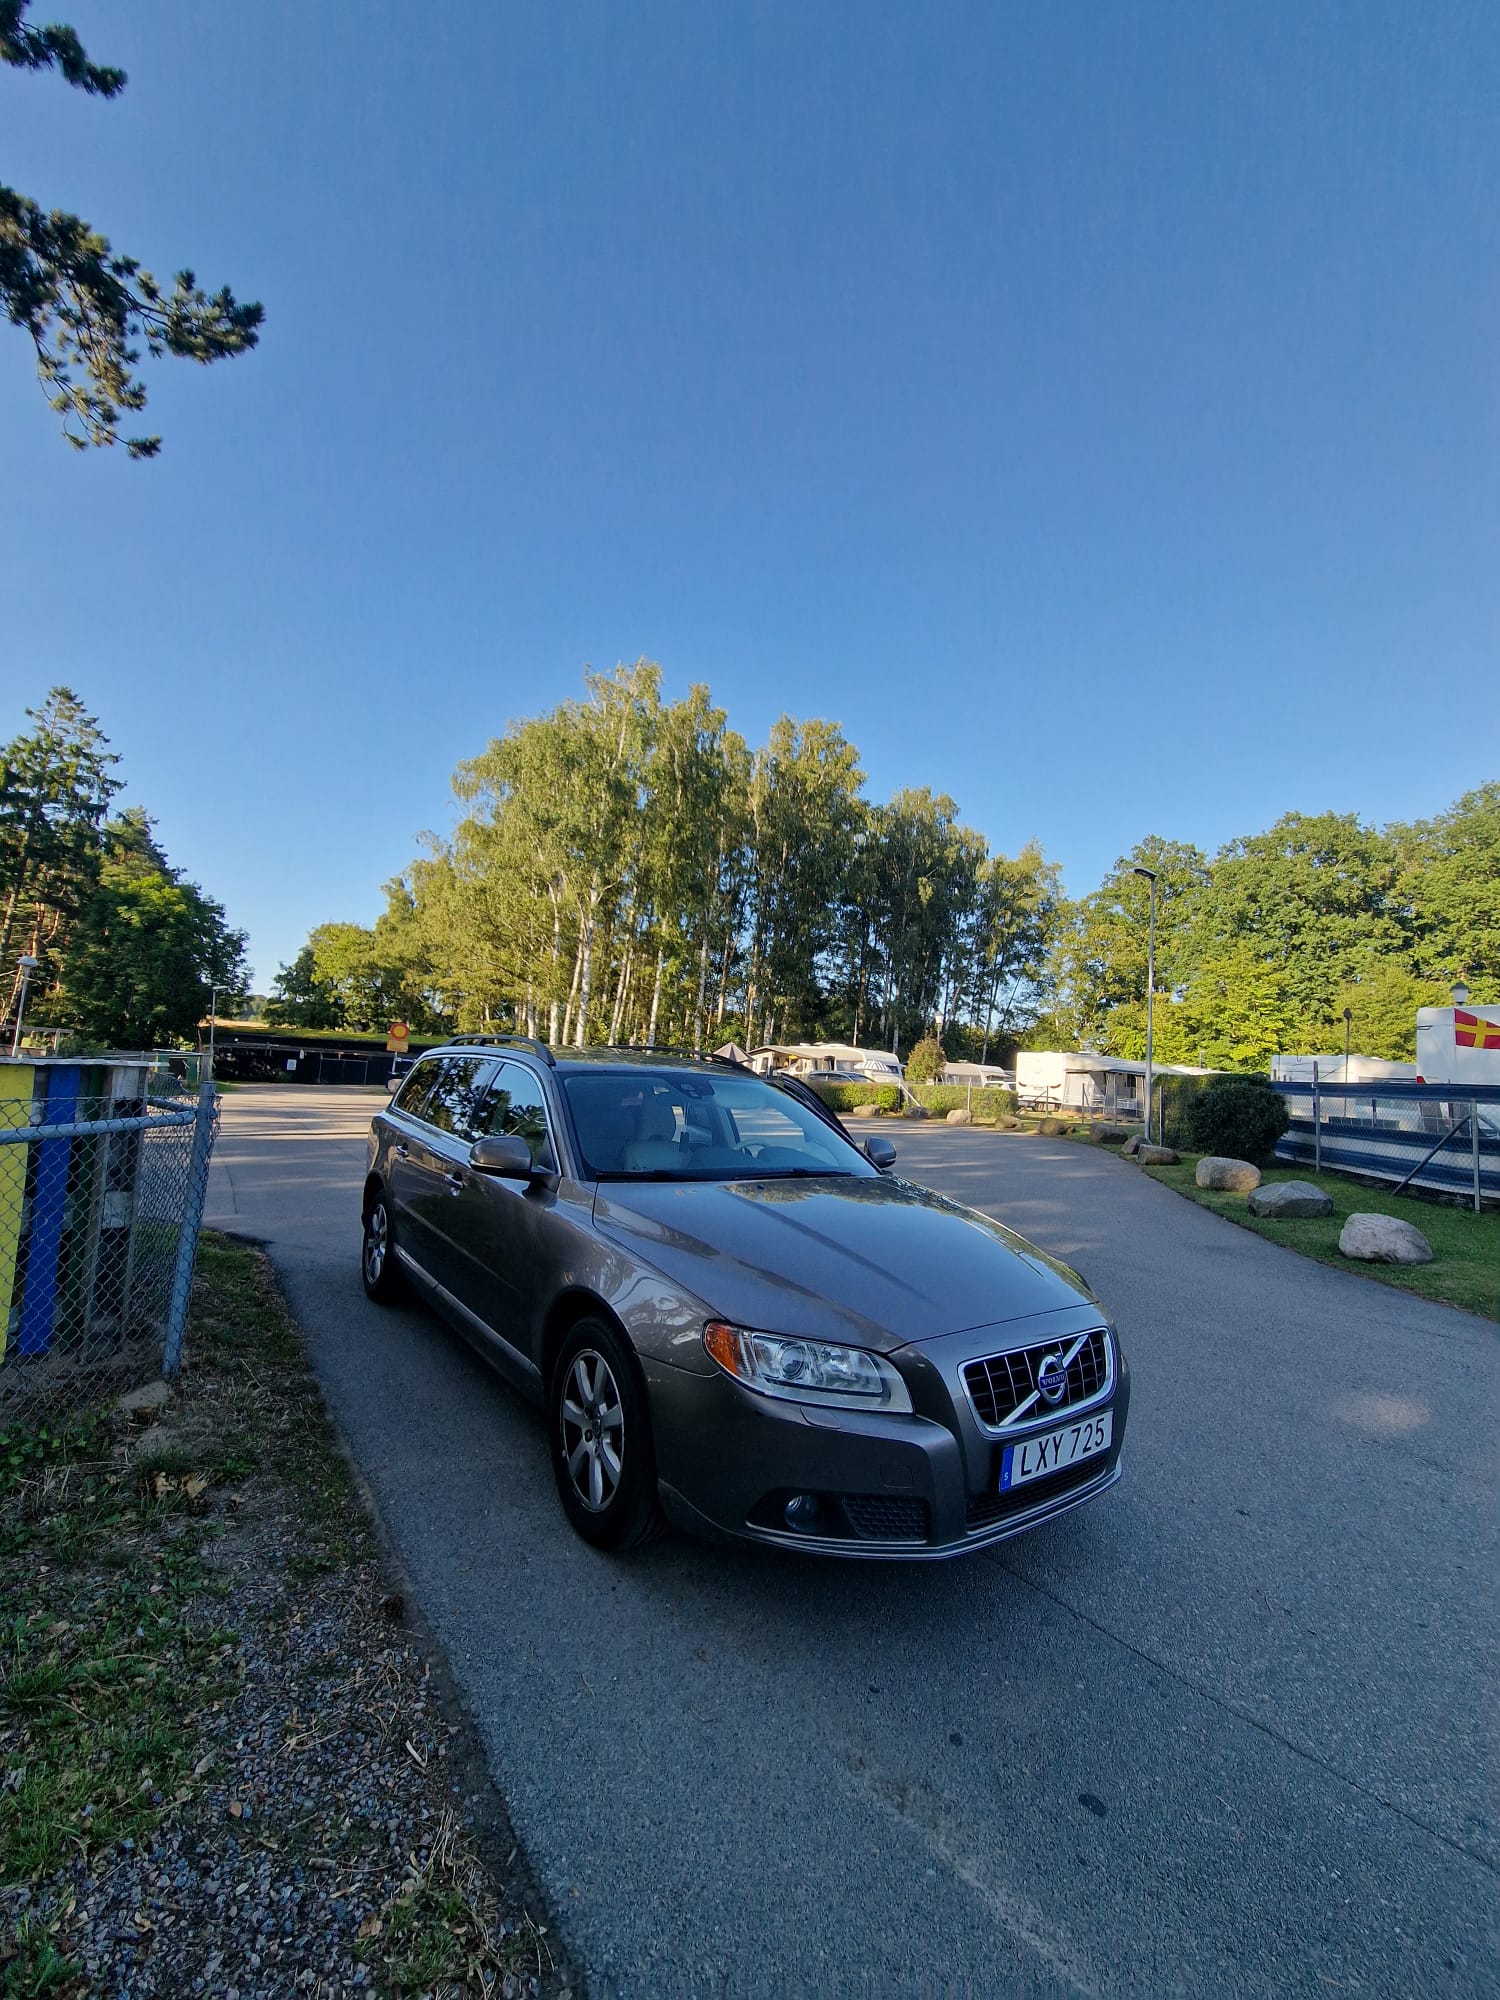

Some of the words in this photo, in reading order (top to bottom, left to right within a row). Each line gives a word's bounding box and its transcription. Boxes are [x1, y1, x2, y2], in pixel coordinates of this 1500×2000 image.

[1042, 1374, 1065, 1386] VOLVO
[1021, 1432, 1065, 1477] LXY
[1070, 1417, 1105, 1459] 725
[1004, 1471, 1009, 1481] S
